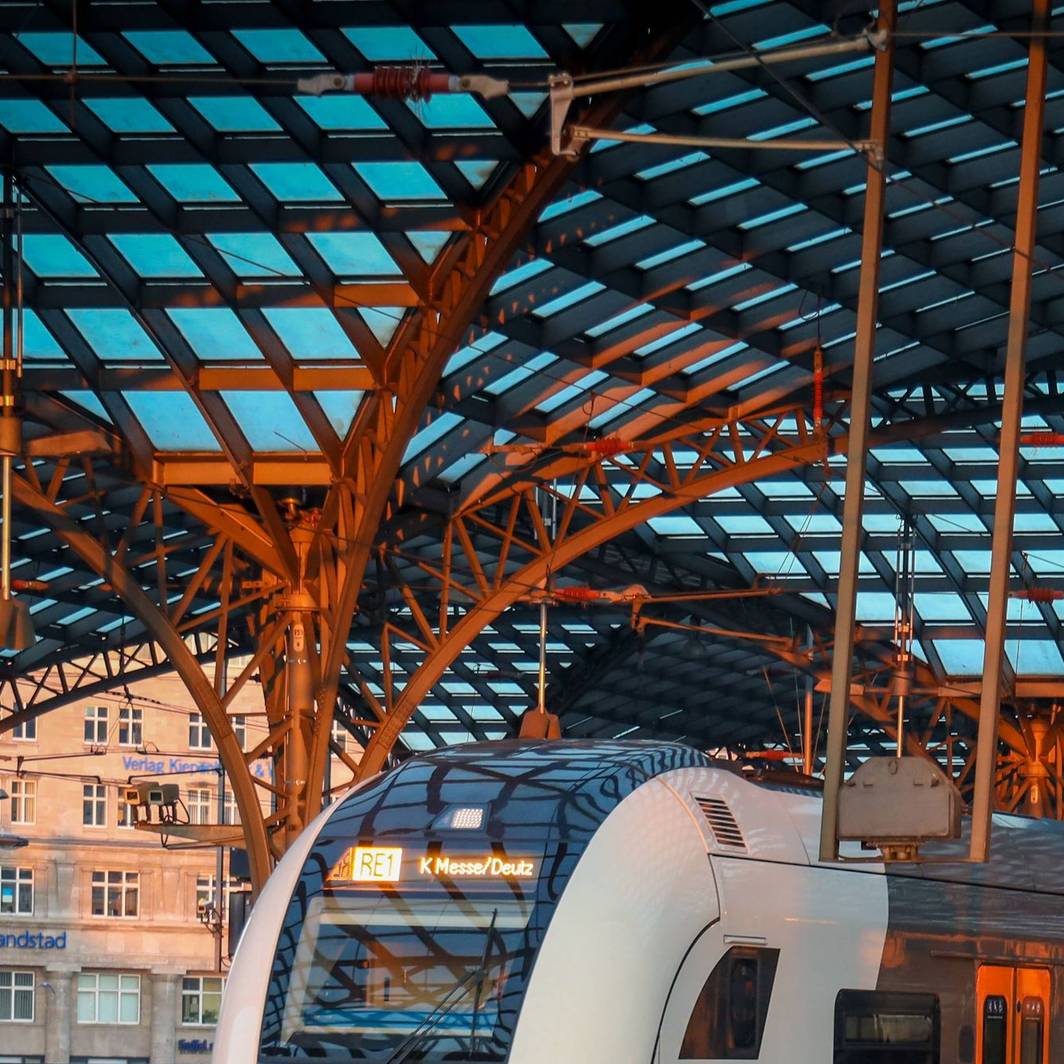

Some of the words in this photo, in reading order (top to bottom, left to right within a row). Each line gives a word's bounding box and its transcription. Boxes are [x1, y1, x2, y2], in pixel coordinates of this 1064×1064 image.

[122, 757, 164, 775] Verlag
[360, 853, 394, 877] RE1
[420, 857, 432, 874] K
[434, 856, 534, 876] Messe/Deutz
